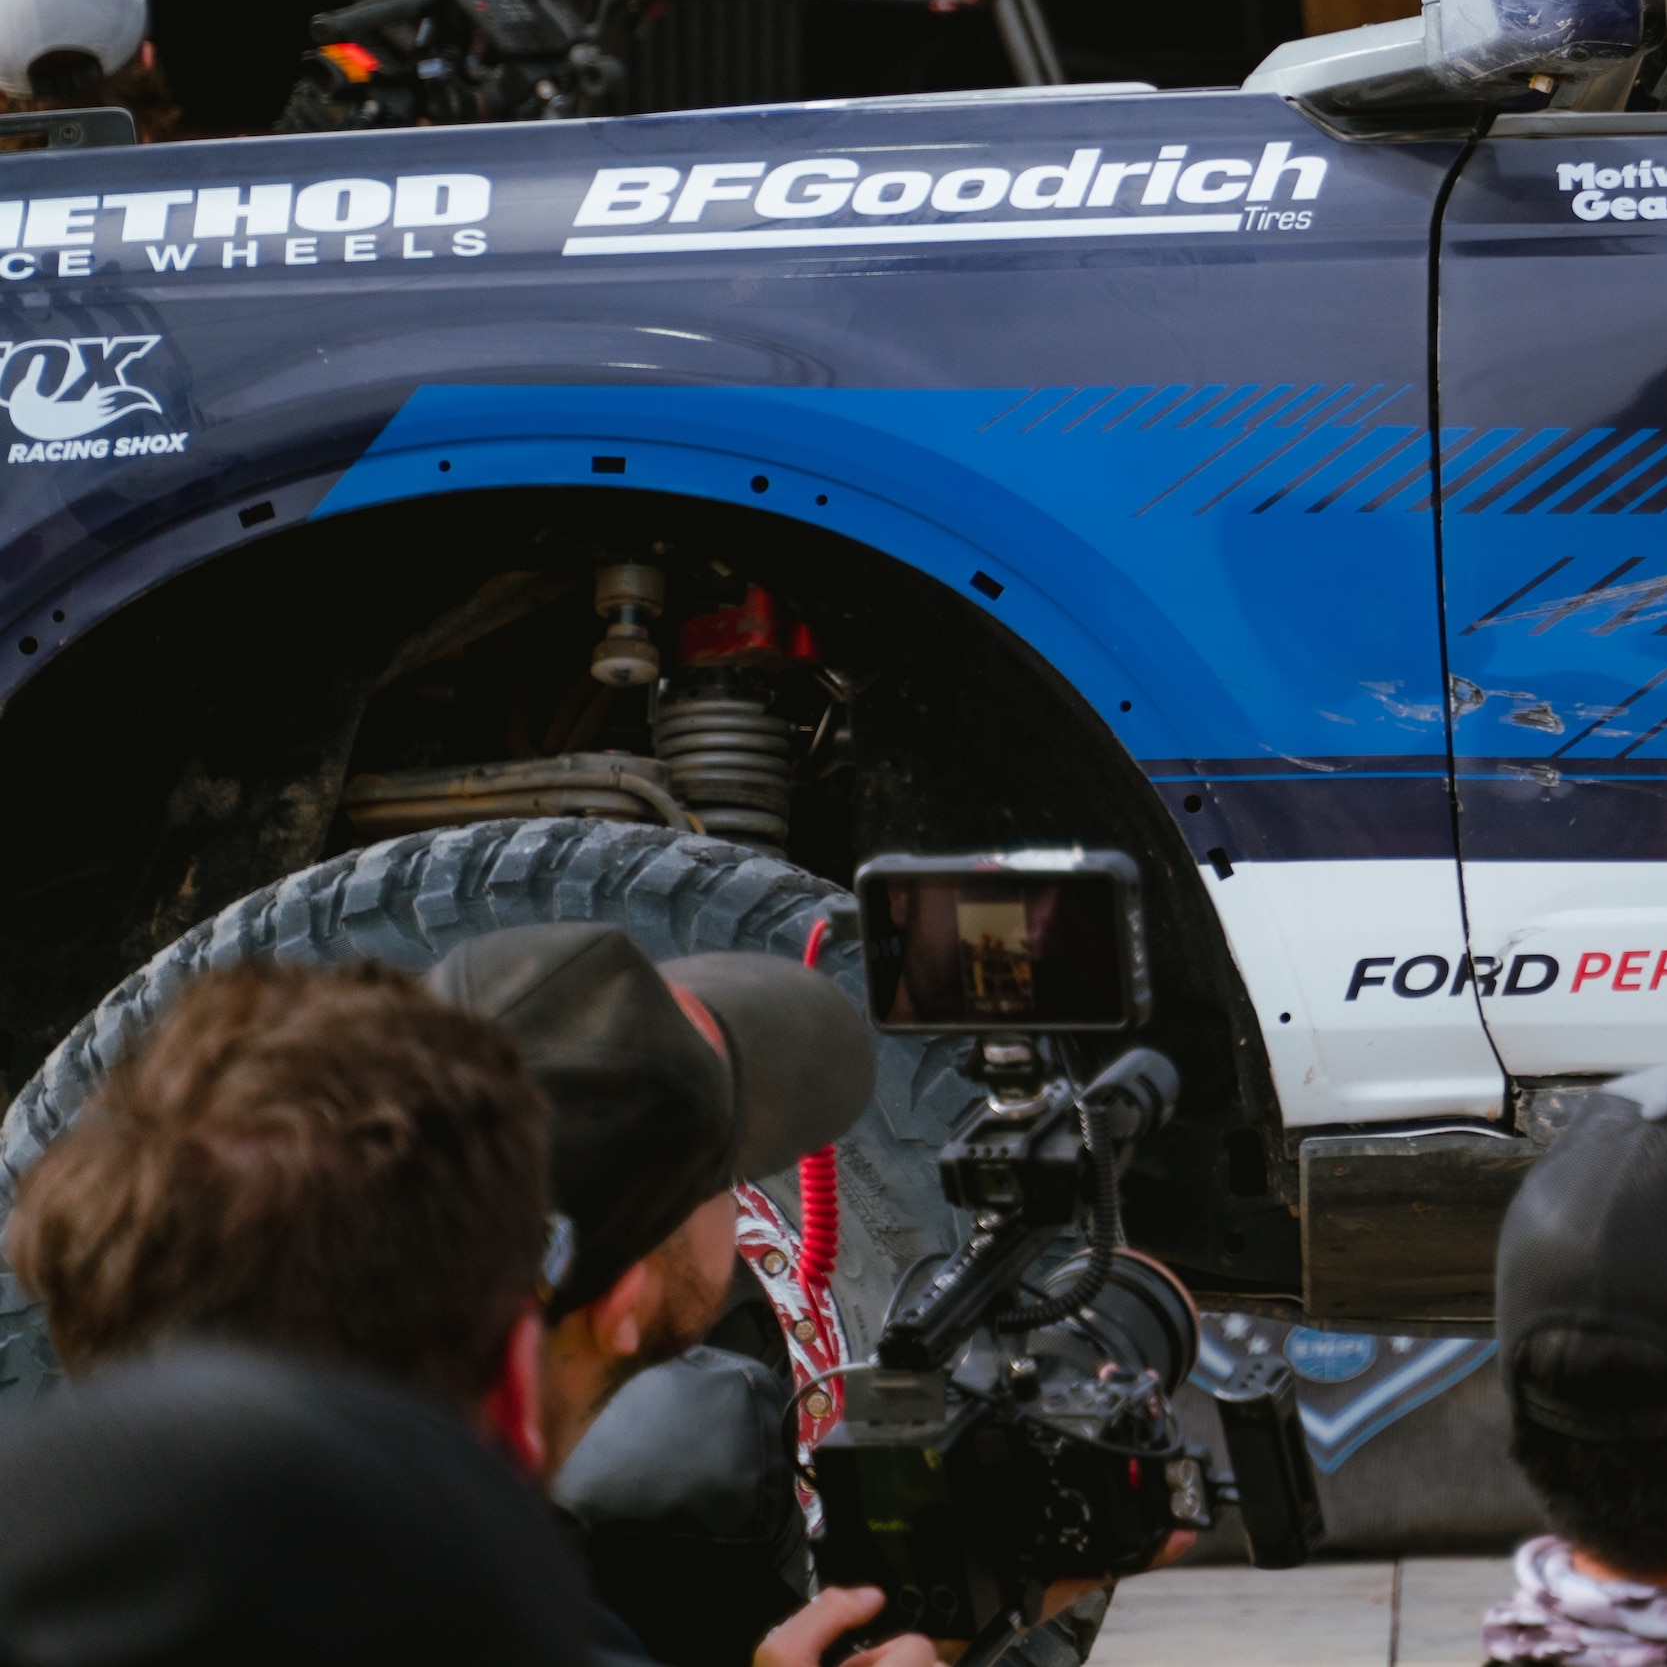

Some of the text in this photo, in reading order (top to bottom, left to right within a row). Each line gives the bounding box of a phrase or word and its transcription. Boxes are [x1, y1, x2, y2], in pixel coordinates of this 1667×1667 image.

[573, 141, 1328, 228] BFGoodrich
[1243, 206, 1312, 231] Tires
[0, 229, 488, 281] CE WHEELS
[0, 334, 162, 417] OX
[7, 432, 188, 464] RACING SHOX
[1345, 953, 1559, 1001] FORD
